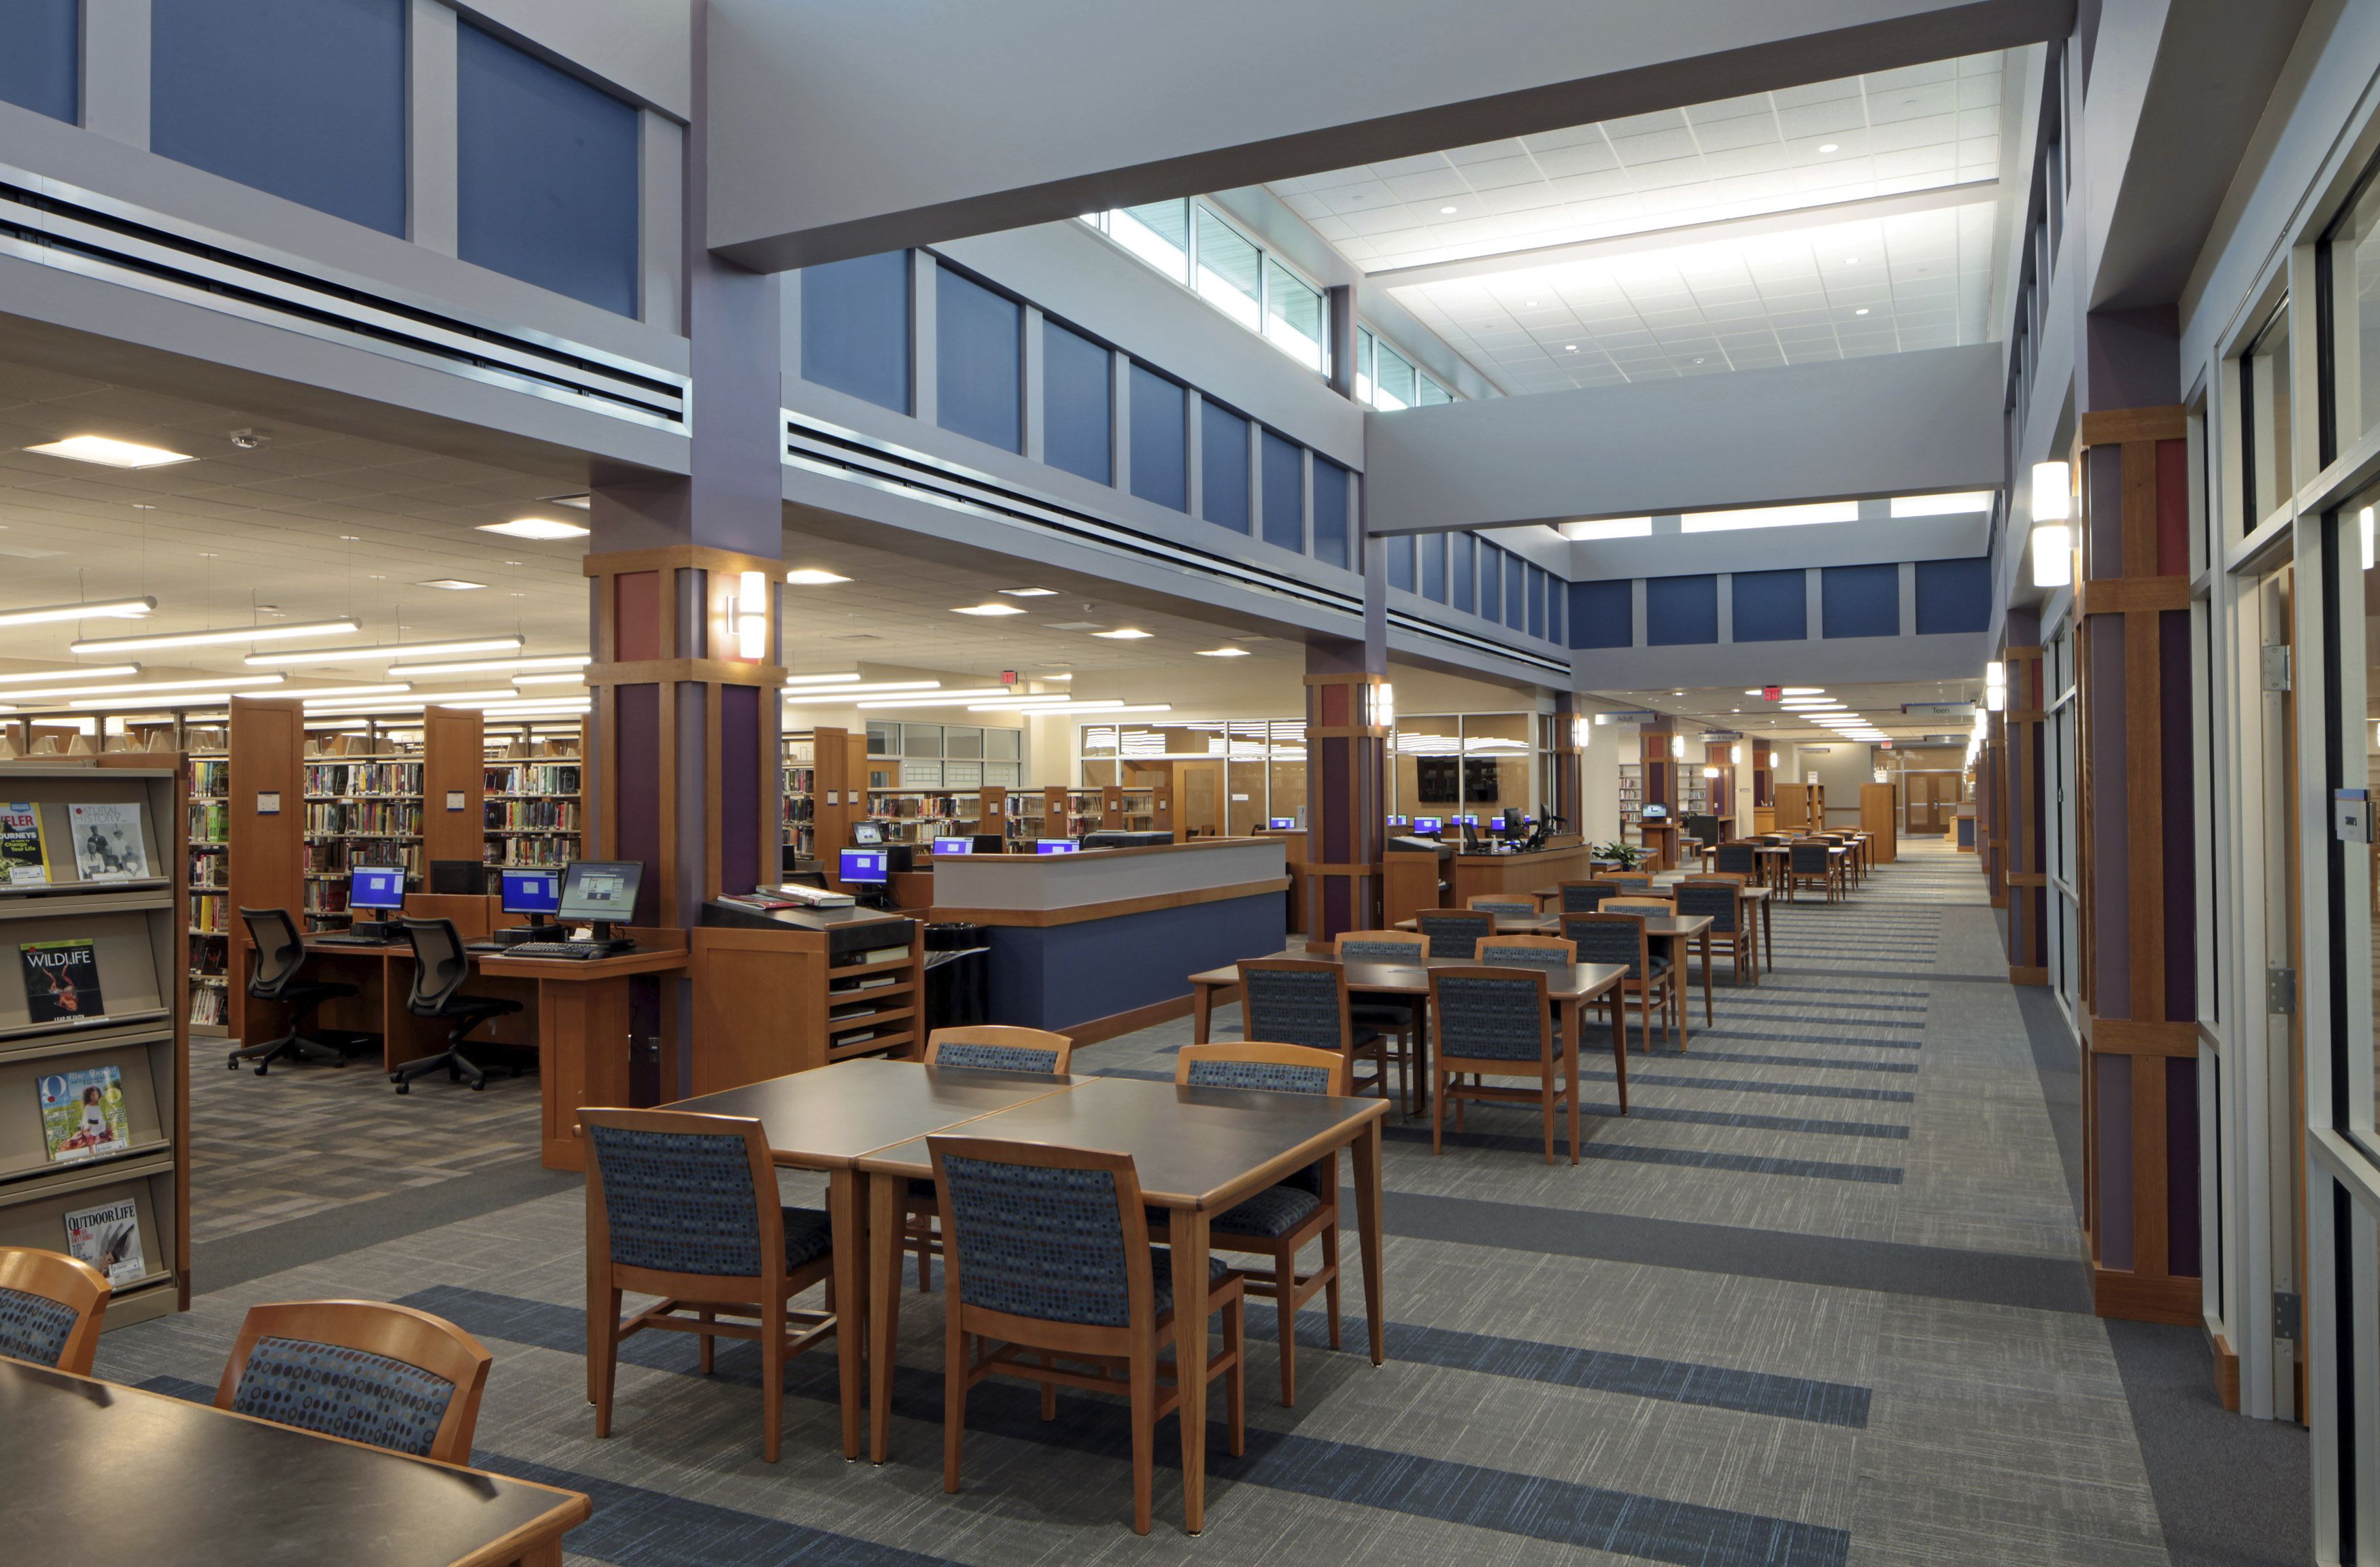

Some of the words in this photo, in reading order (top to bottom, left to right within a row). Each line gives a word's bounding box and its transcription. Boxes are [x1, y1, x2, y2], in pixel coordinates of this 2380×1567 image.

[1764, 688, 1781, 701] EXIT
[74, 813, 121, 823] HISTORY
[27, 950, 91, 967] WILDLIFE
[69, 1071, 86, 1080] Rise
[42, 1075, 67, 1097] O
[69, 1210, 115, 1231] OUTDOOR
[114, 1205, 135, 1221] LIFE
